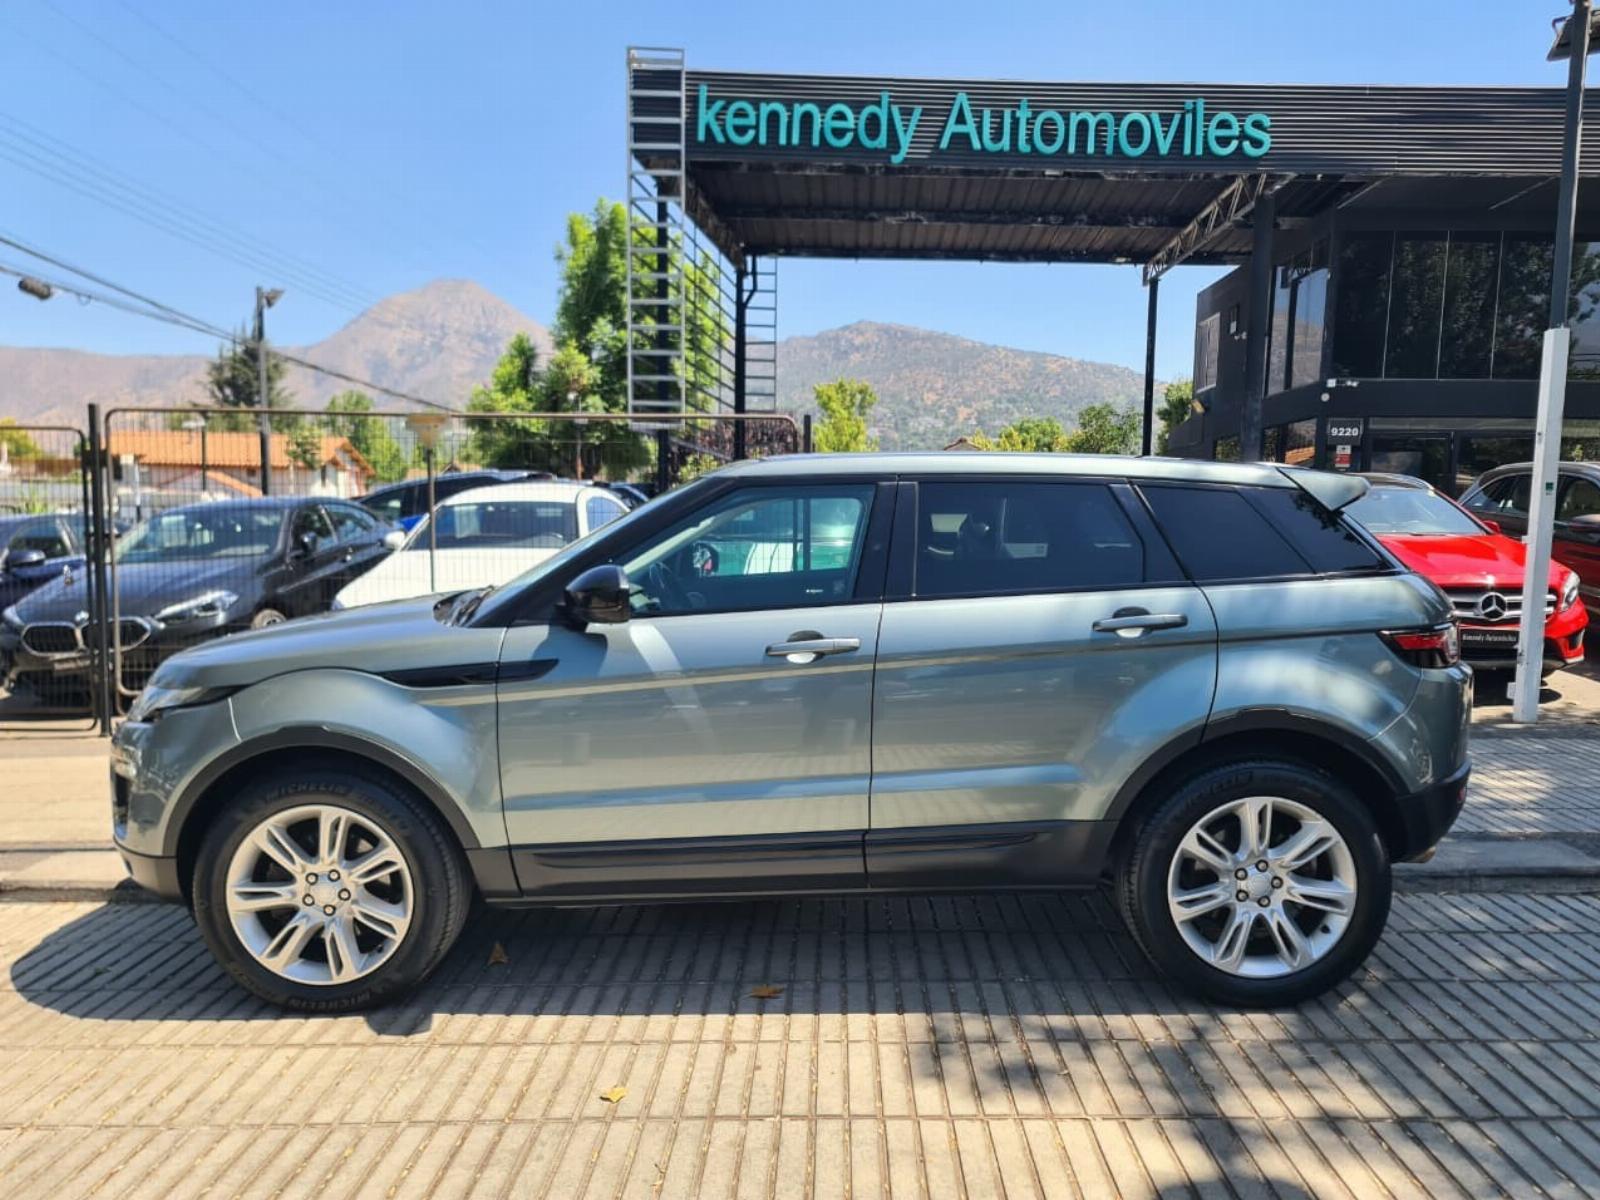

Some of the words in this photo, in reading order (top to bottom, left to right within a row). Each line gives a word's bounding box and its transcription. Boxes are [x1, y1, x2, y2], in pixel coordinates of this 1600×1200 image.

[697, 84, 923, 165] kennedy
[939, 92, 1272, 158] Automoviles
[1331, 427, 1359, 436] 9220
